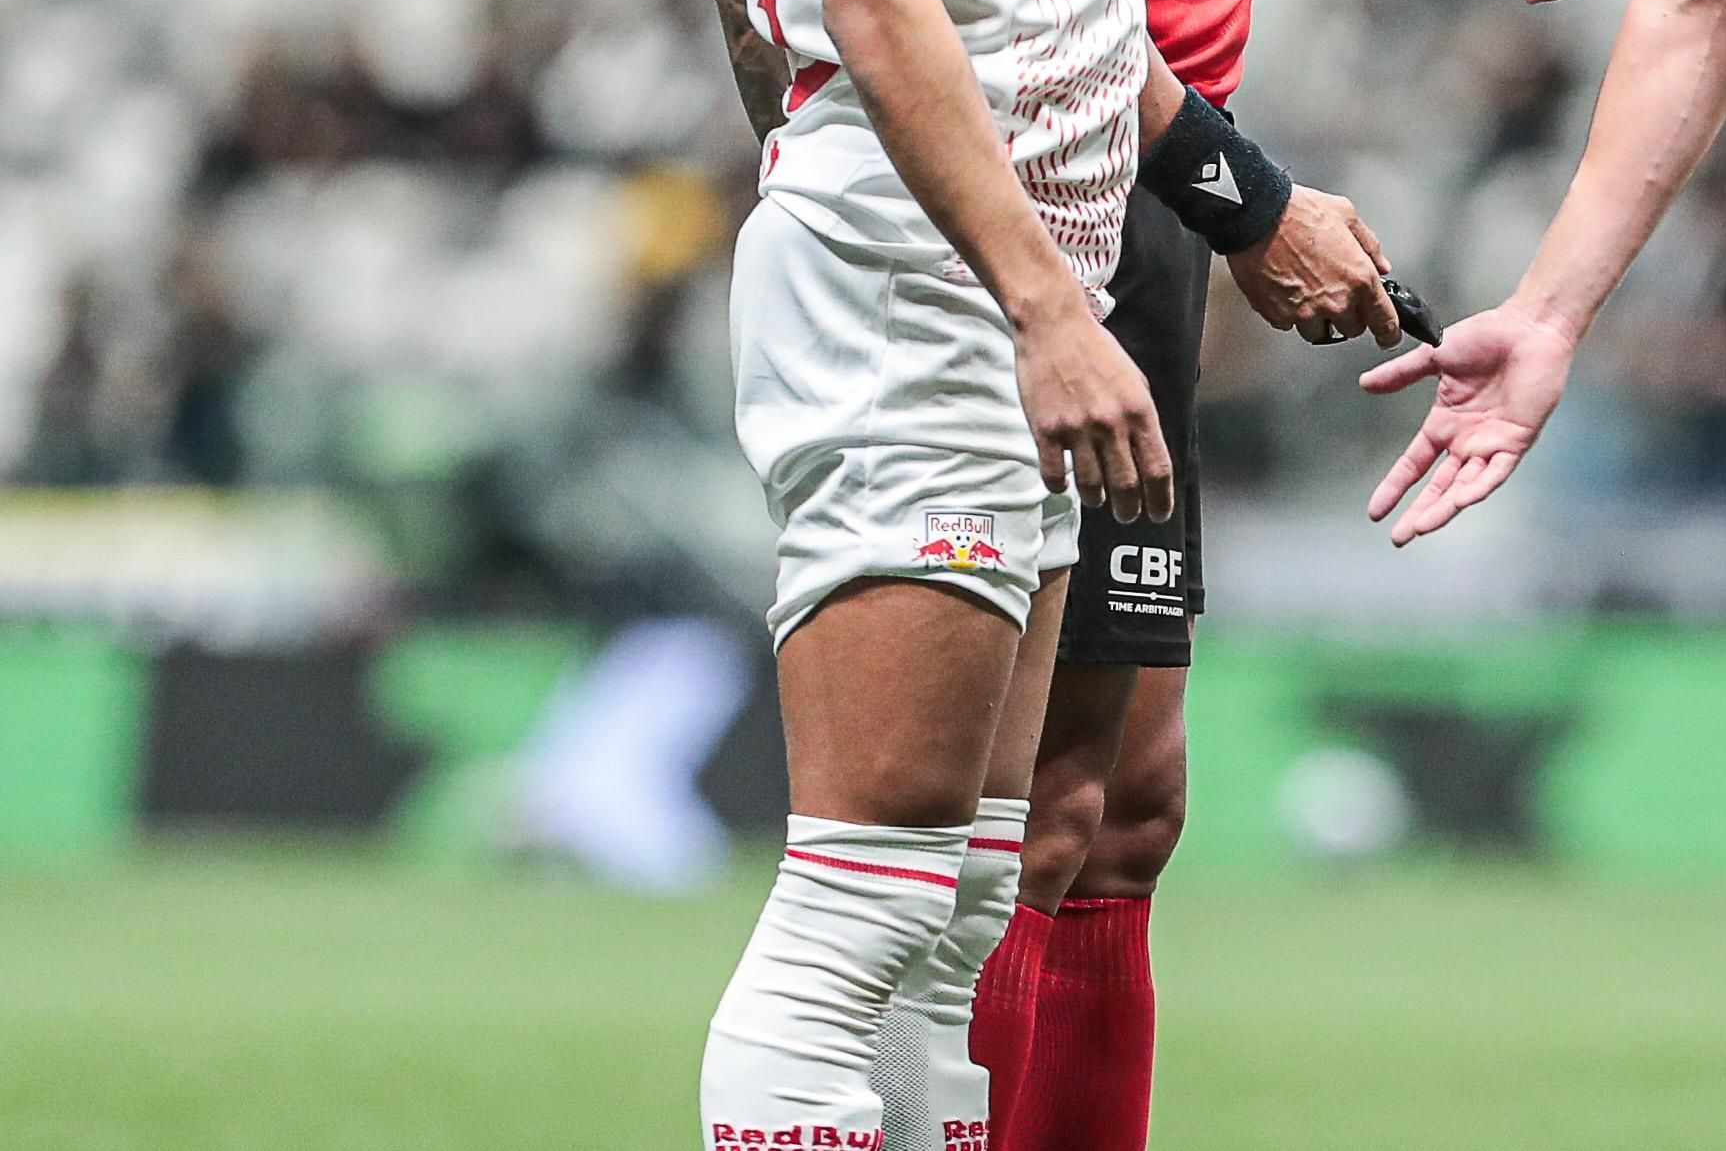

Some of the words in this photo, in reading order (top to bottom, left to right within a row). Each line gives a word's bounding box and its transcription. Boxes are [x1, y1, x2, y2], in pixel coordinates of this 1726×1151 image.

[930, 517, 961, 532] Red
[964, 517, 990, 535] Bull
[1110, 545, 1183, 588] CBF
[1108, 601, 1134, 613] TIME
[713, 1123, 801, 1145] Red
